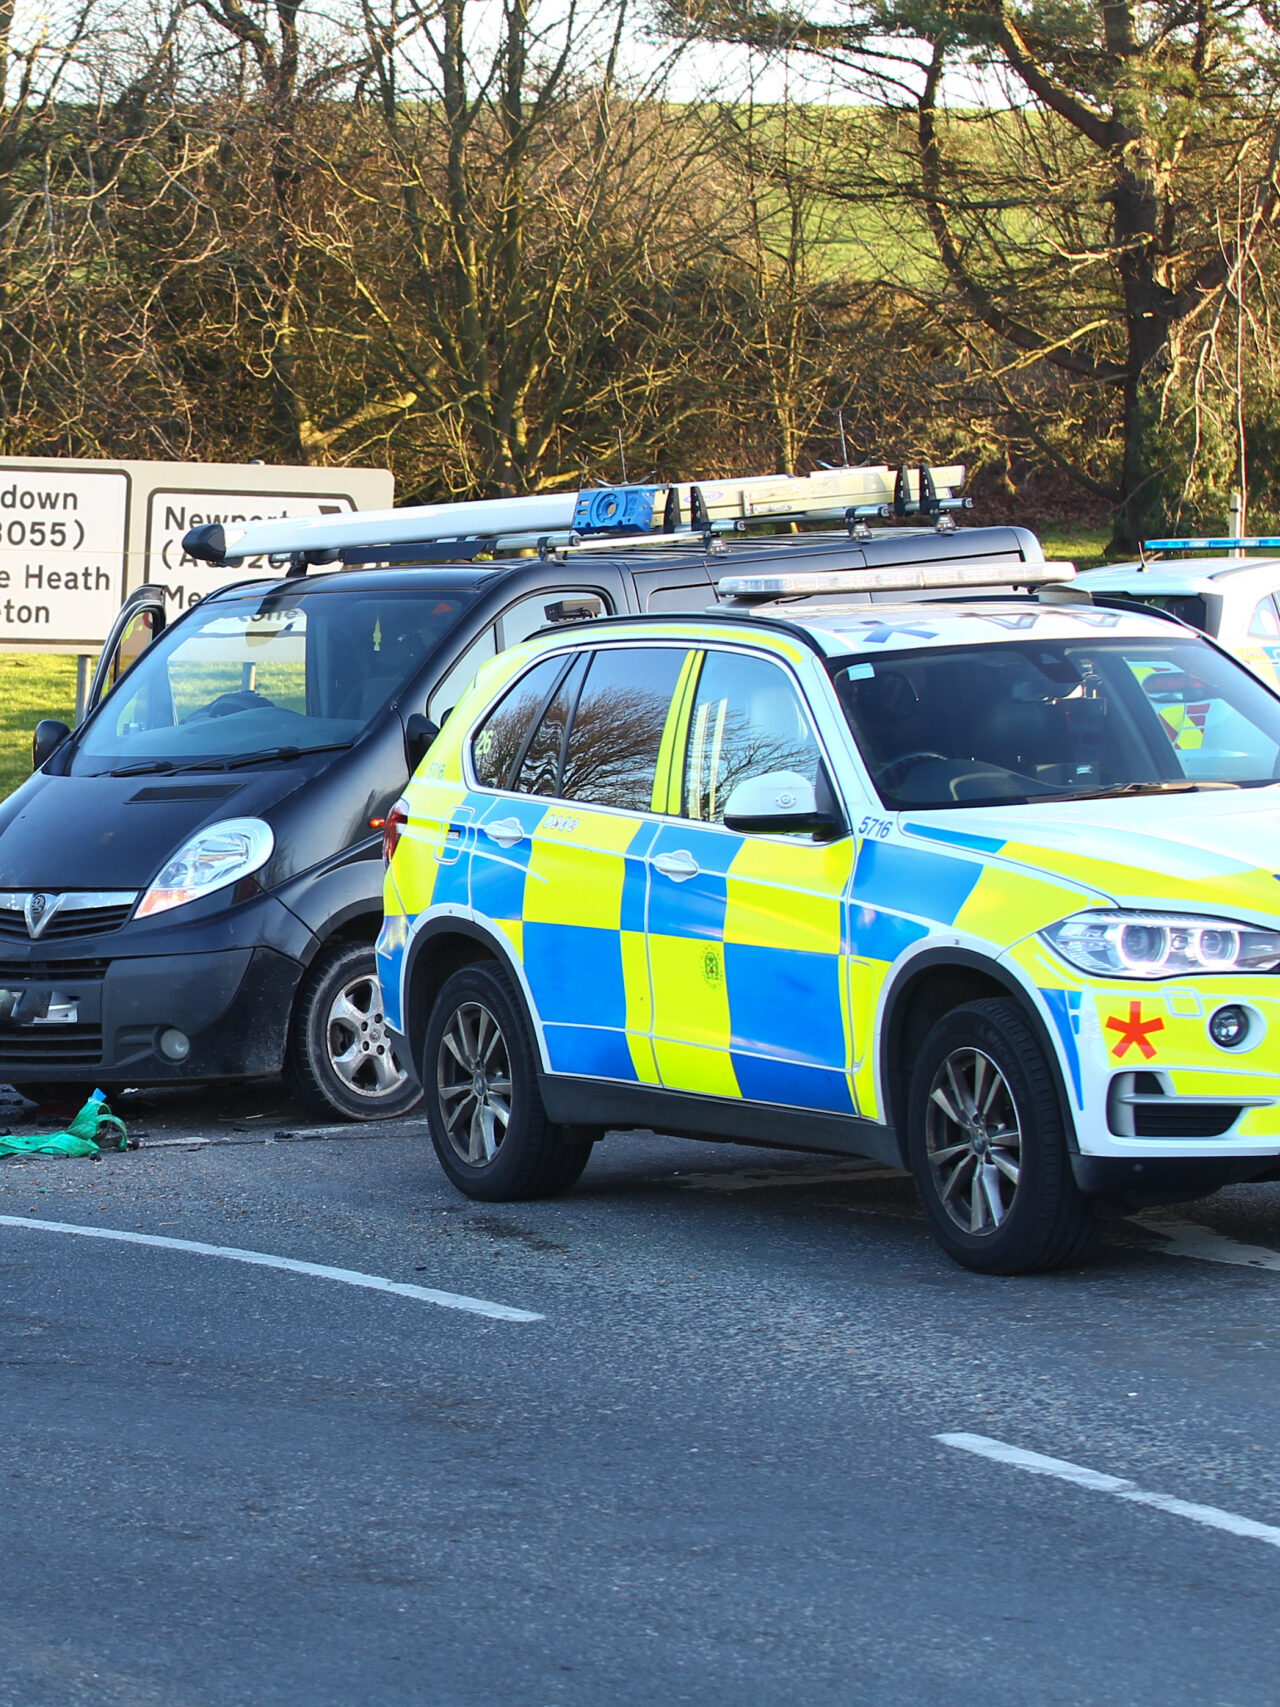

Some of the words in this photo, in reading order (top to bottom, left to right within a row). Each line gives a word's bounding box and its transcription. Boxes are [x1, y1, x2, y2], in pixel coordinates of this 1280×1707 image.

[25, 565, 110, 591] Heath
[475, 730, 494, 755] 26
[858, 816, 894, 839] 5716
